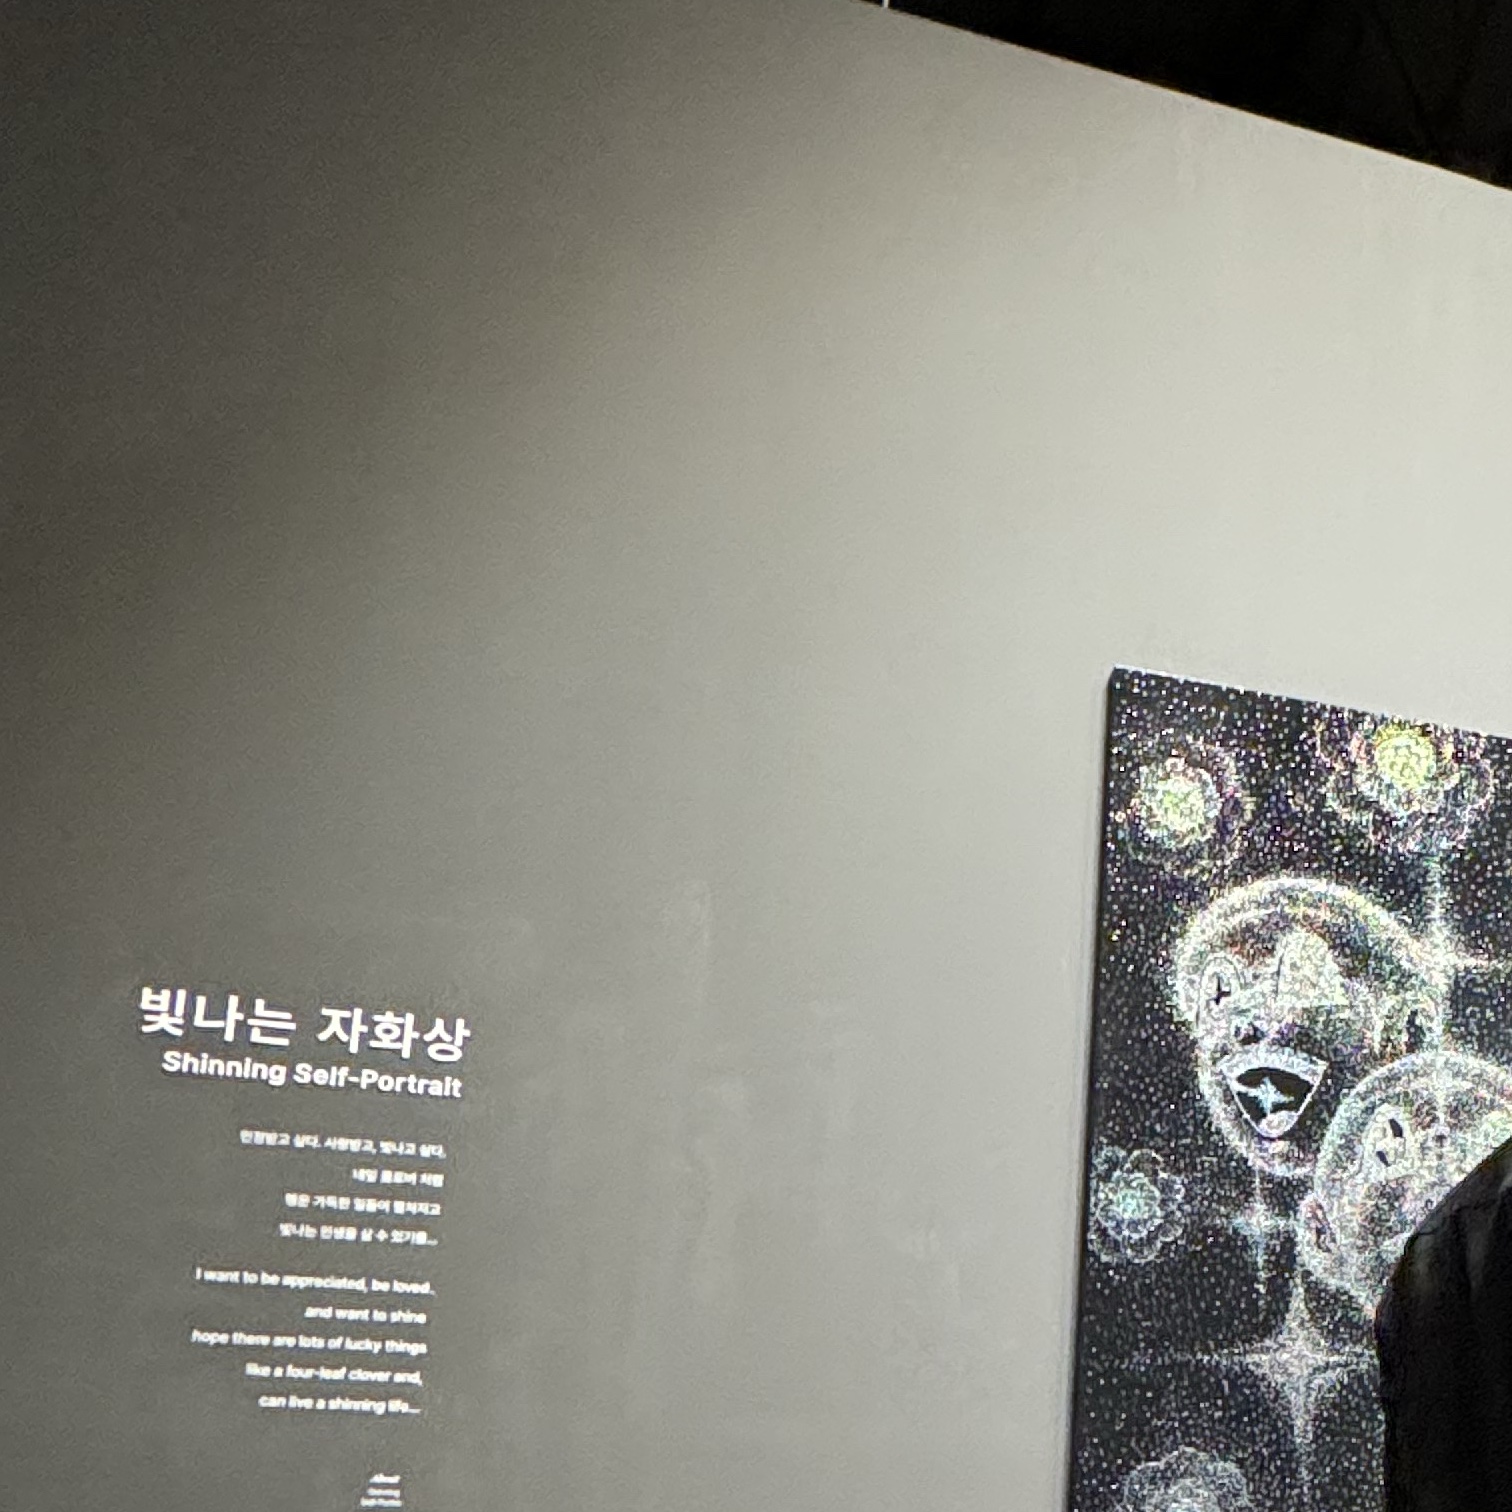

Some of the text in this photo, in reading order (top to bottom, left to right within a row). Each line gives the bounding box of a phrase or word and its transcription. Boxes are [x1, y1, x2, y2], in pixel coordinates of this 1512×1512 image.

[139, 987, 470, 1061] 빛나는 자화상
[162, 1051, 462, 1097] Shinning Self-Portrait
[380, 1141, 416, 1155] 빛나고
[280, 1223, 317, 1238] 빛나는
[196, 1267, 202, 1279] I
[204, 1271, 240, 1283] want
[242, 1271, 258, 1284] to
[260, 1271, 280, 1285] be
[371, 1279, 390, 1292] be
[304, 1307, 426, 1324] and want to shine
[191, 1329, 427, 1356] hope there are lots of lucky things
[246, 1363, 271, 1377] like
[273, 1367, 284, 1377] a
[348, 1369, 392, 1382] clover
[258, 1396, 286, 1407] can
[288, 1395, 314, 1409] live
[316, 1399, 326, 1409] a
